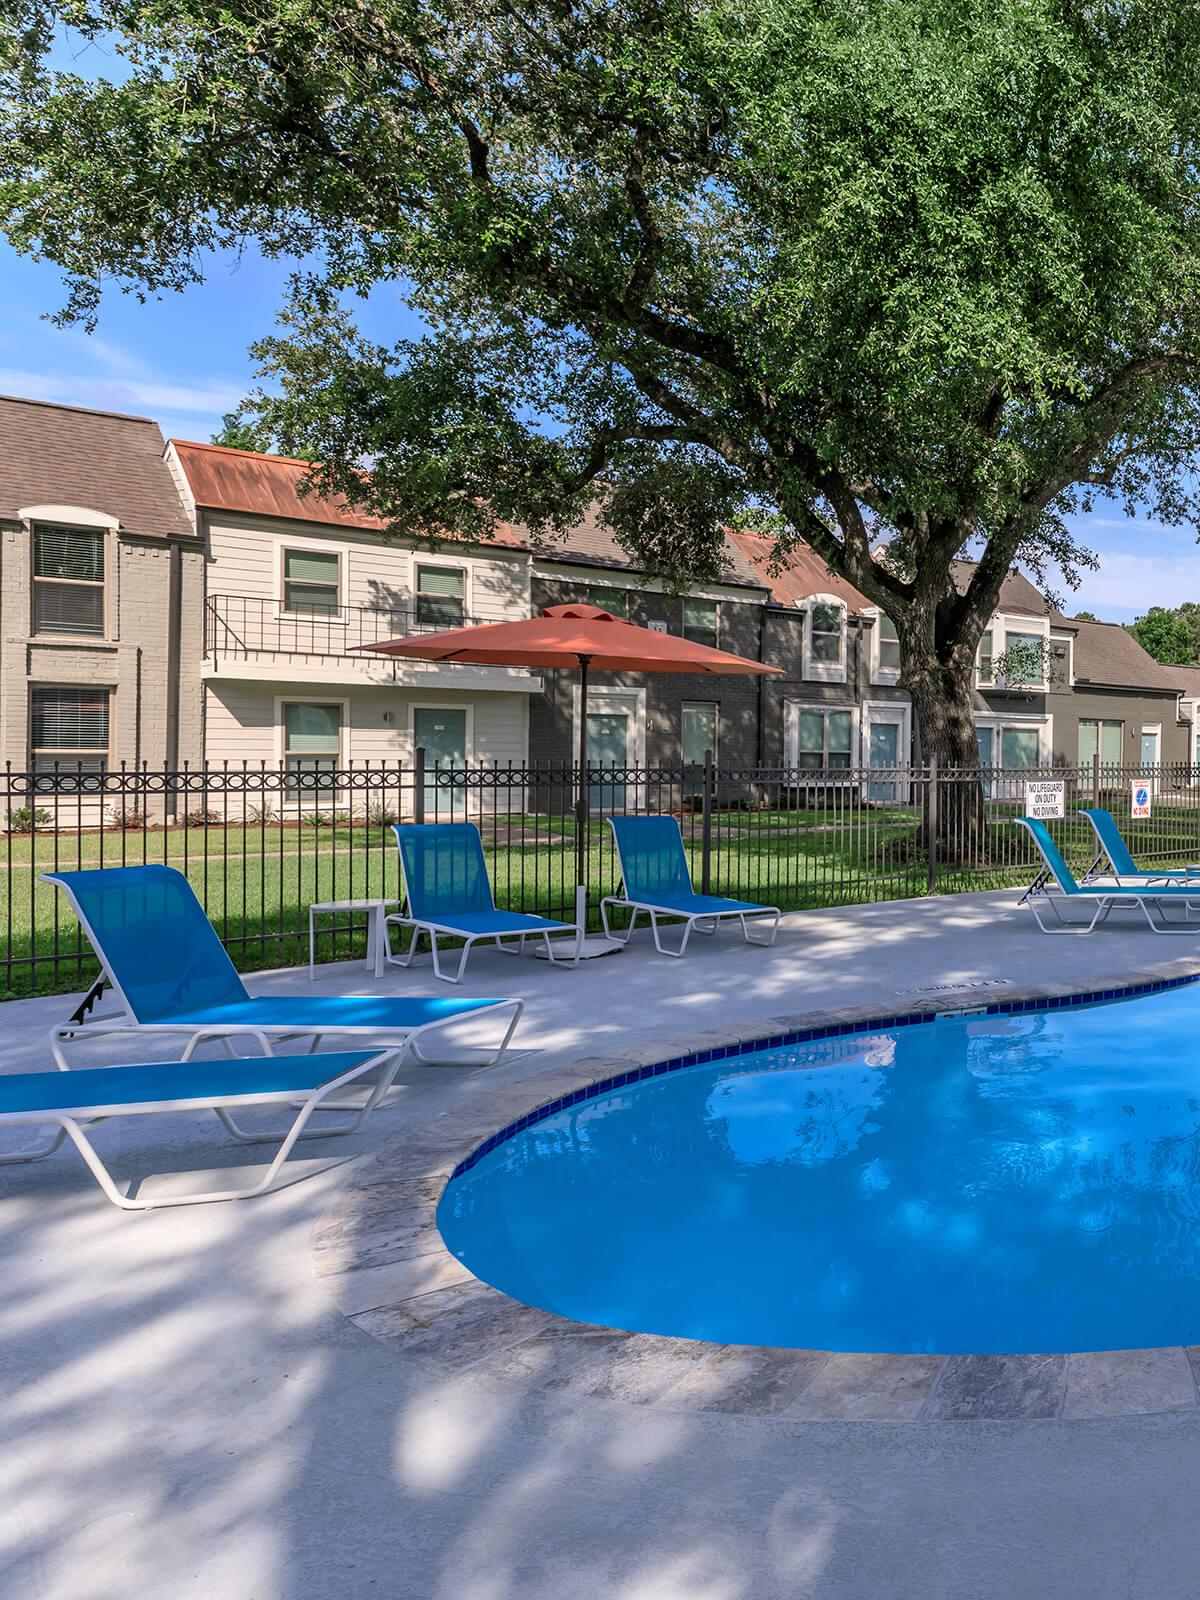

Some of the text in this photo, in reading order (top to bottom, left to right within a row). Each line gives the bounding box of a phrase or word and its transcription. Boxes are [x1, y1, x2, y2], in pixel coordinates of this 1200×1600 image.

[1029, 783, 1063, 792] NO LIFEGUARD
[1035, 793, 1056, 803] ON DUTY
[1033, 806, 1058, 816] NO DIVING
